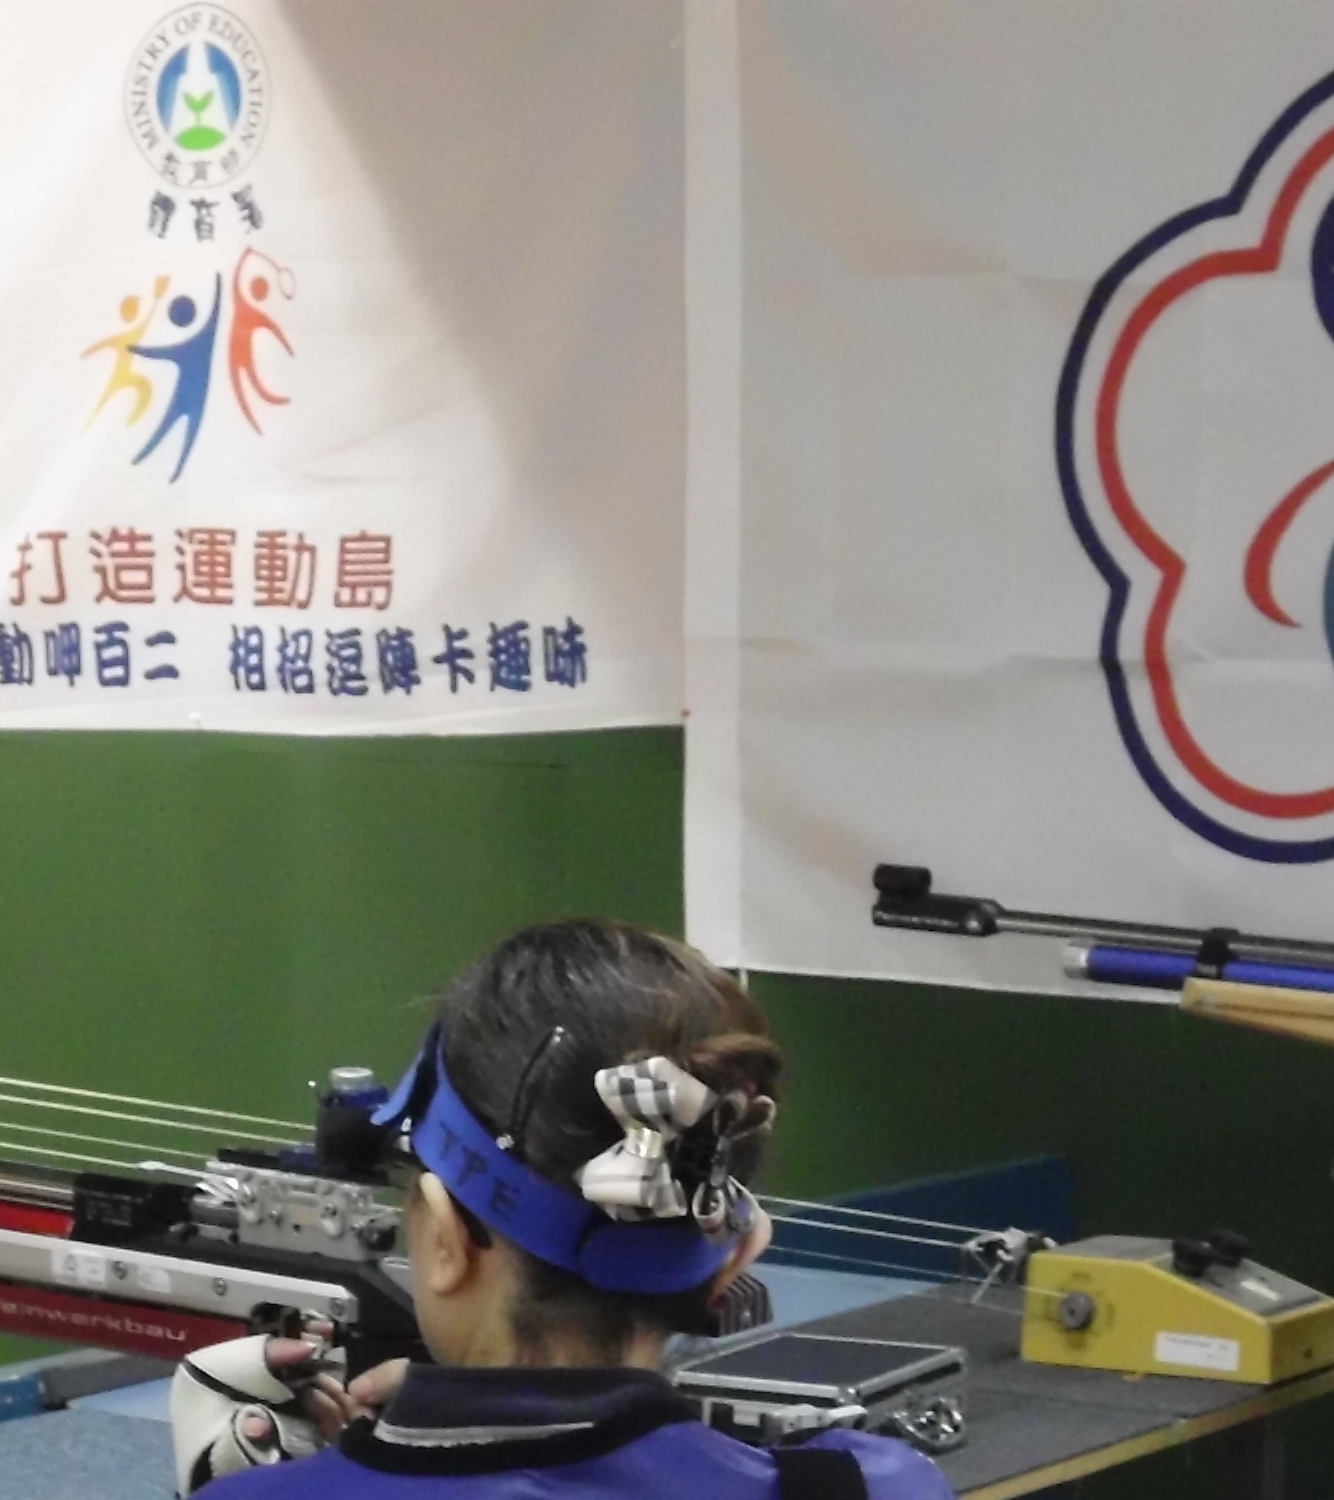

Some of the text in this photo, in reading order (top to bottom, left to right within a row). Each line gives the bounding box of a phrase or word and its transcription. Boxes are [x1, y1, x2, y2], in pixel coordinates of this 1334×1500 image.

[7, 527, 395, 611] 打造運動島
[438, 1121, 523, 1222] TPE
